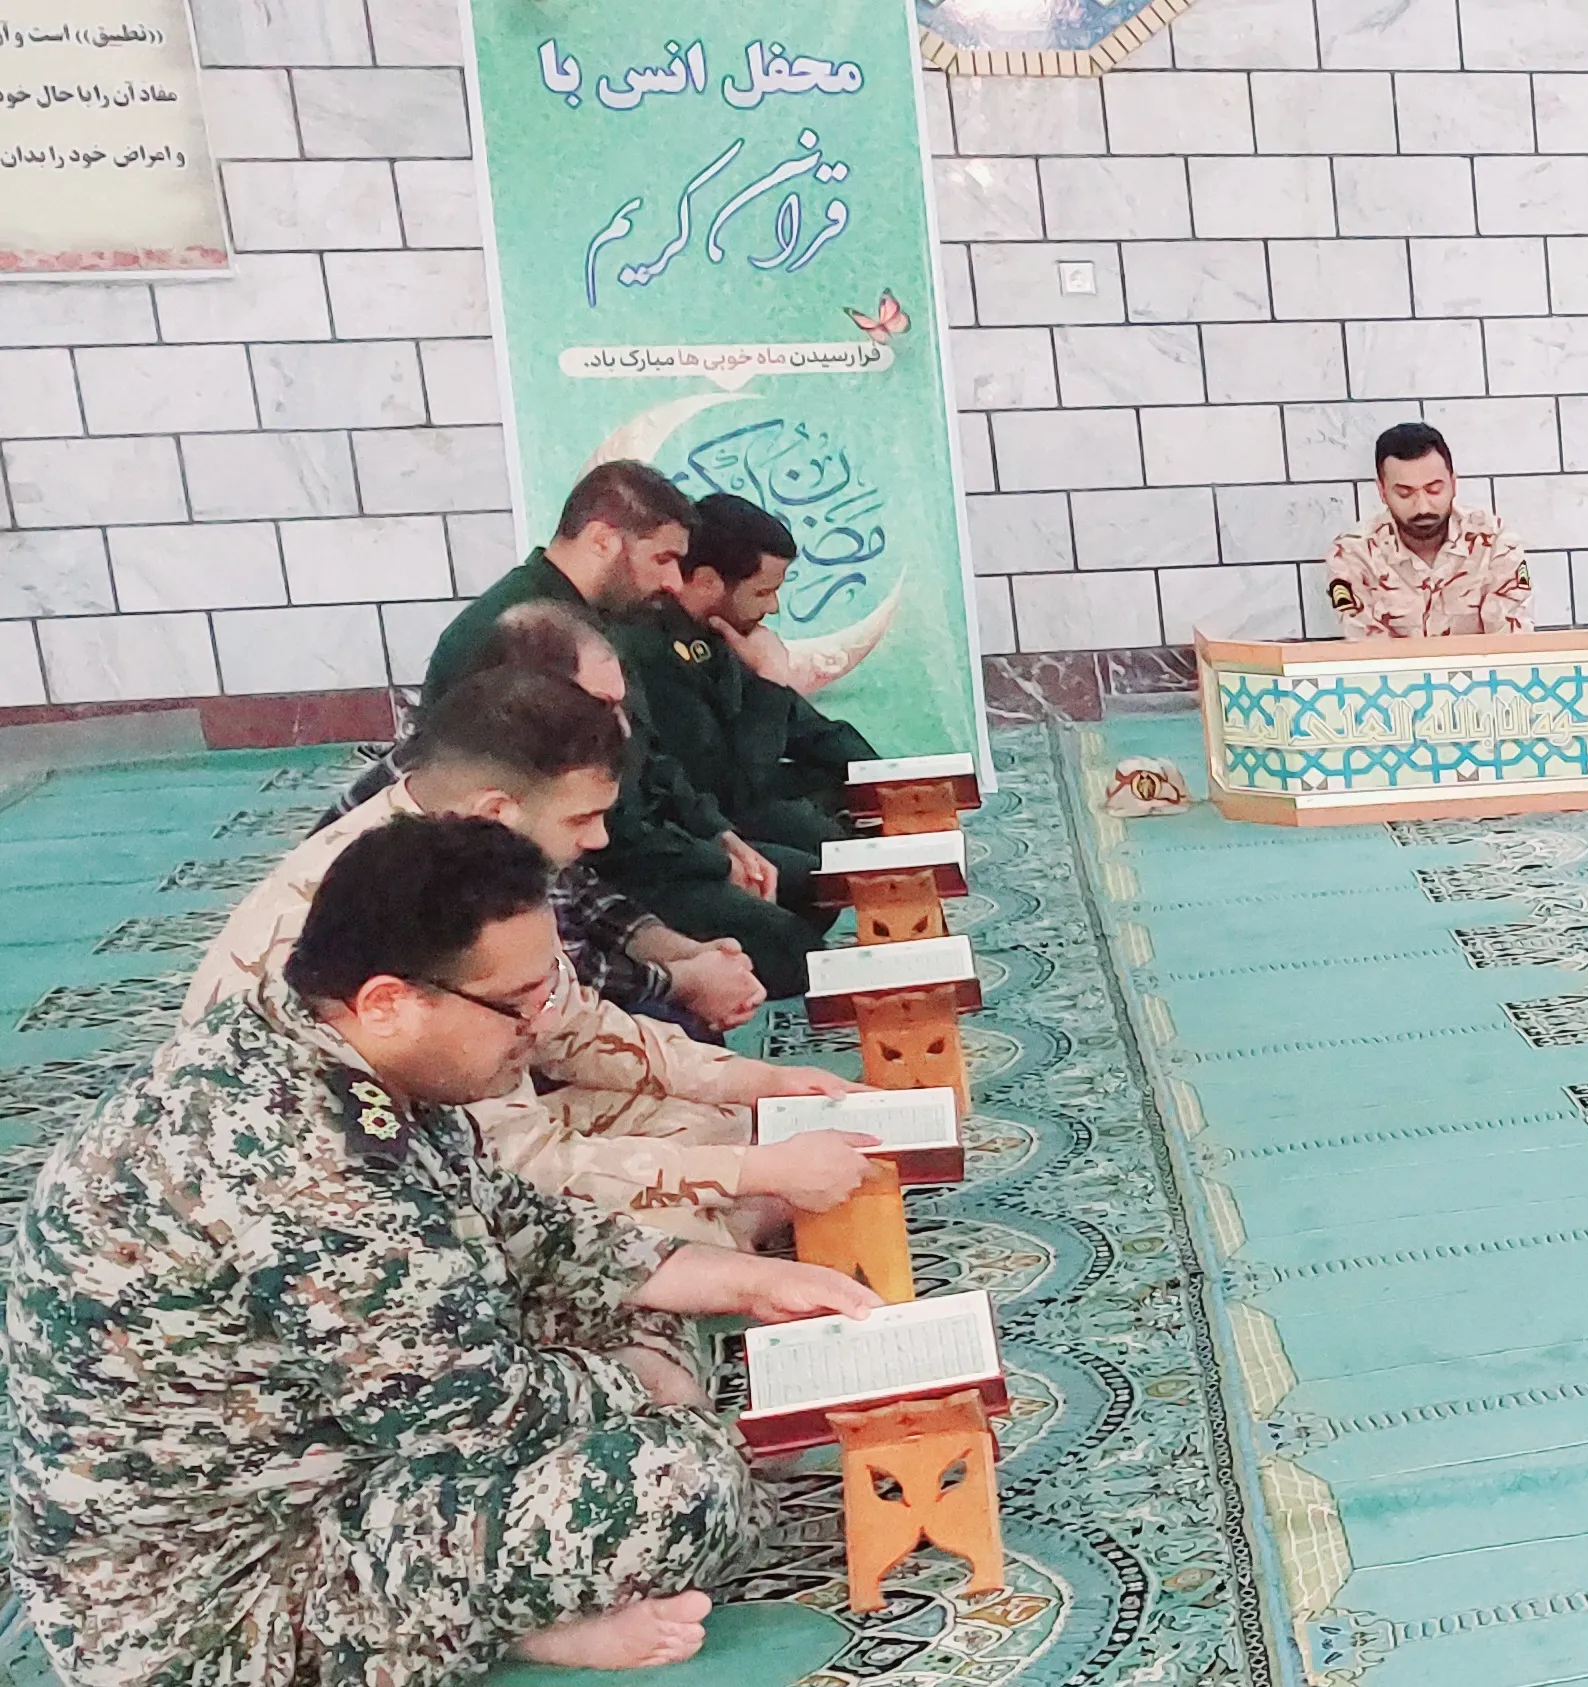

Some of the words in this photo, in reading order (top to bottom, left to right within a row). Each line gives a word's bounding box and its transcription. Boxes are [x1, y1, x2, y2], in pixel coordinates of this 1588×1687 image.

[15, 31, 24, 48] و
[28, 23, 70, 43] است
[537, 38, 583, 109] با
[597, 38, 708, 111] انس
[723, 39, 864, 111] محفل
[37, 85, 74, 108] حال
[77, 85, 92, 108] با
[93, 85, 110, 108] را
[113, 80, 137, 107] آن
[141, 83, 178, 102] مفاد
[1, 146, 46, 169] بدان
[48, 146, 64, 168] را
[69, 146, 107, 168] خود
[113, 145, 171, 168] امراض
[177, 151, 186, 168] و
[585, 137, 745, 308] کریم
[583, 350, 615, 372] باد.
[620, 349, 675, 373] مبارک
[678, 348, 700, 367] ها
[703, 348, 753, 372] خوبی
[757, 347, 786, 366] ماه
